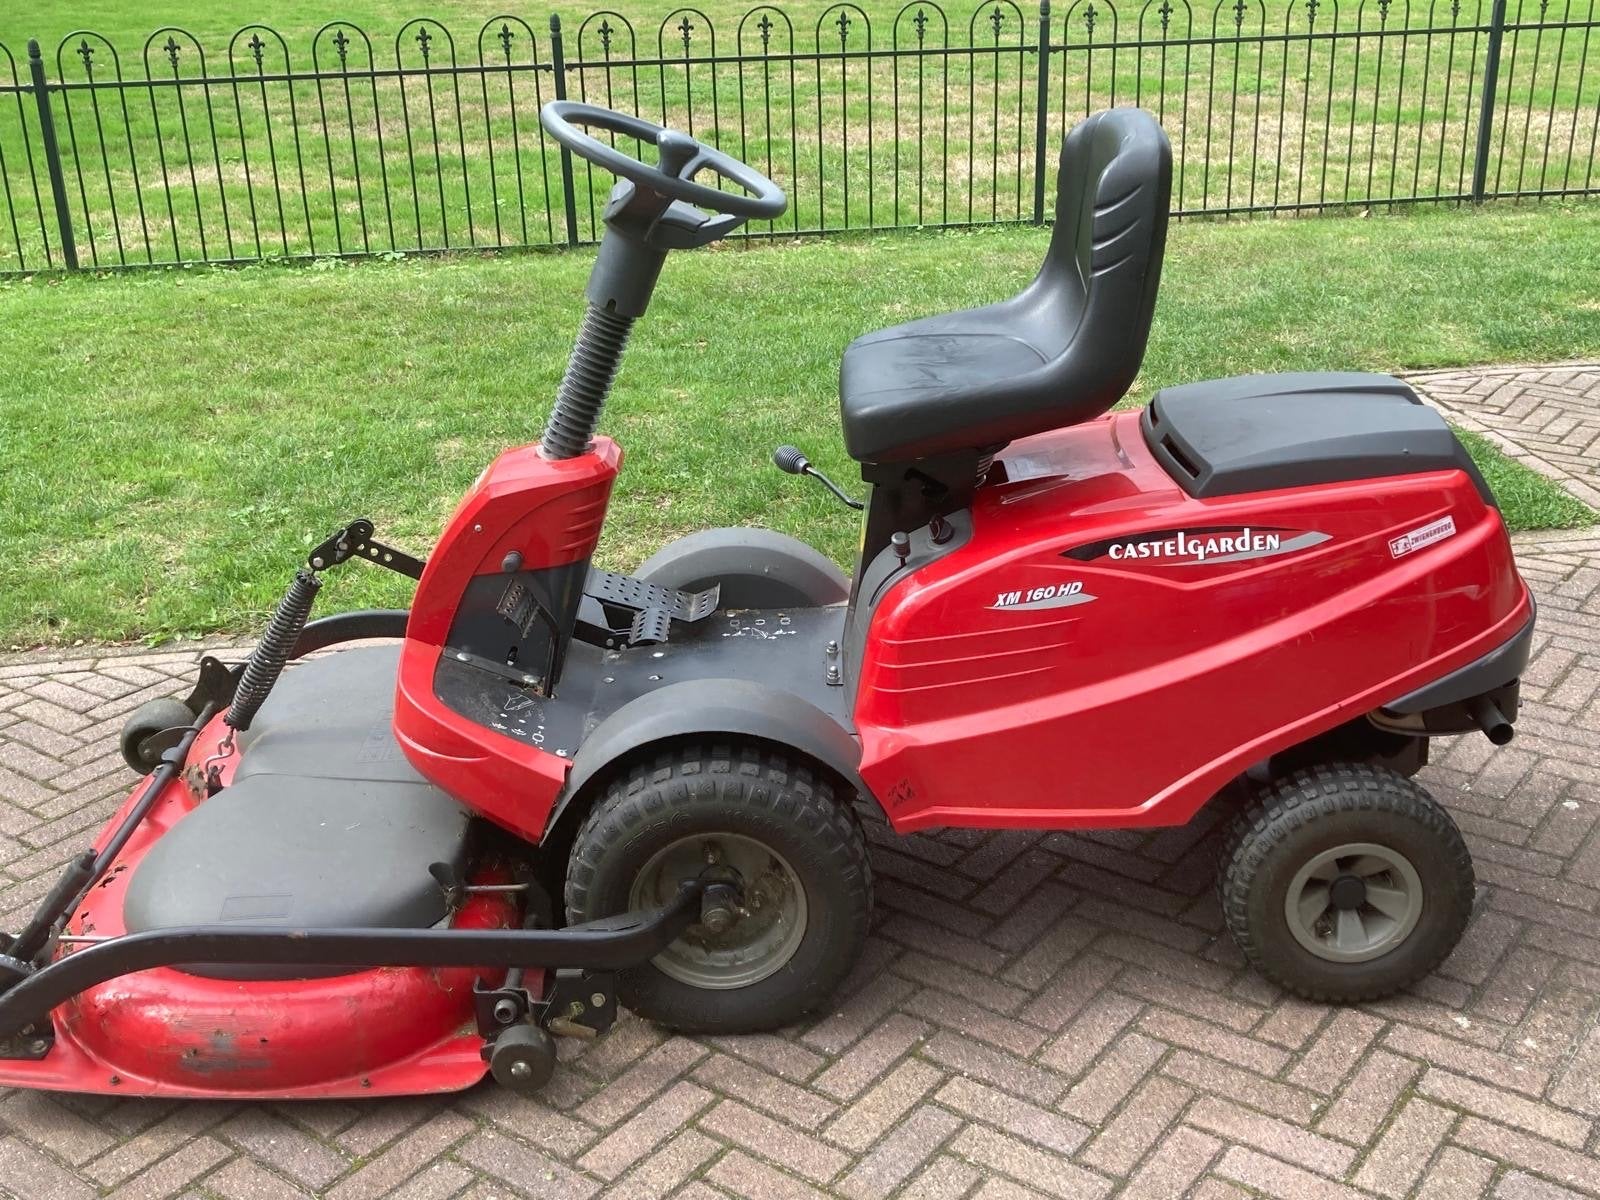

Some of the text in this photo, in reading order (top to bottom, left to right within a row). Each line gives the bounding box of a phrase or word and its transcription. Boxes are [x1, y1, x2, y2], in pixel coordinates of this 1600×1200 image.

[993, 581, 1083, 608] XM 160 HD
